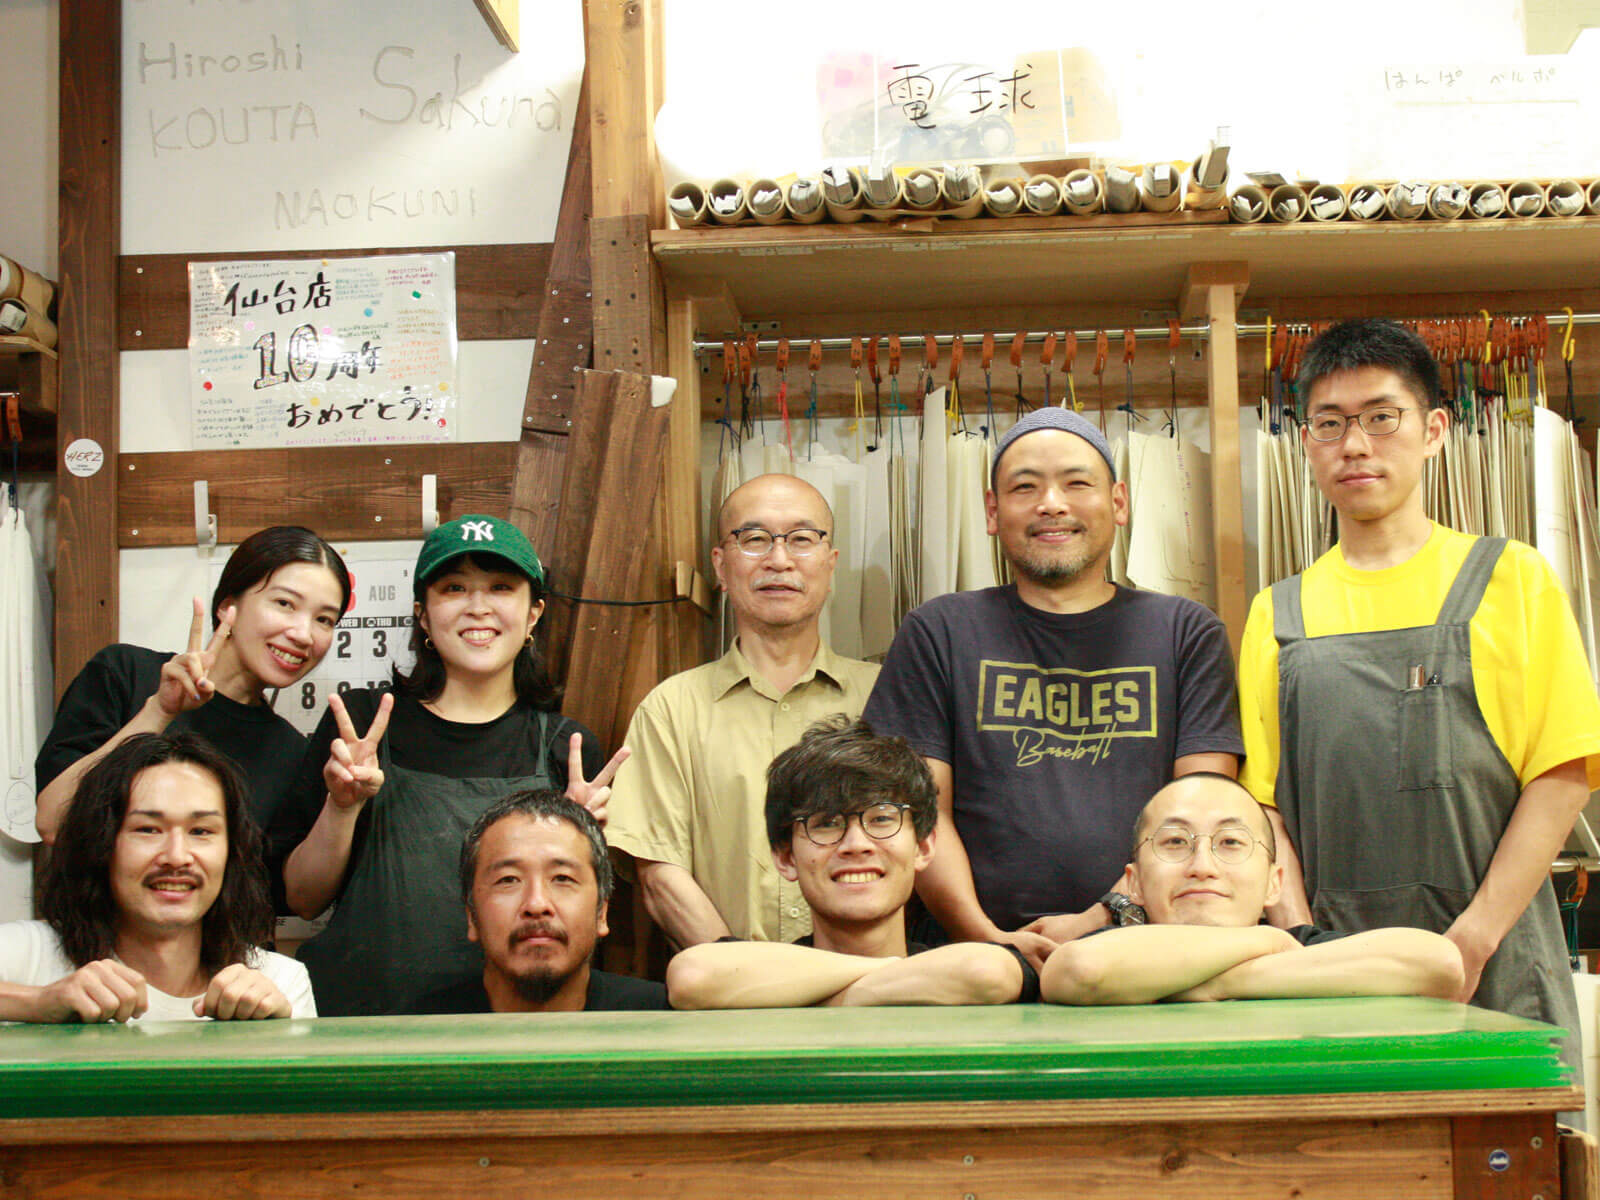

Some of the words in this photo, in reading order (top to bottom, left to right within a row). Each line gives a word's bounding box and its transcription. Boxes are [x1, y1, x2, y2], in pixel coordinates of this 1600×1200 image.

[138, 34, 303, 84] Hiroshi
[359, 45, 561, 132] Sakura
[887, 63, 1036, 129] 電球
[149, 101, 319, 158] KOUTA
[274, 185, 477, 230] NAOKUNI
[223, 271, 332, 317] 仙台店
[369, 585, 397, 602] AUG
[337, 630, 352, 659] 2
[372, 630, 387, 658] 3
[301, 681, 316, 710] 8
[994, 674, 1140, 727] EAGLES
[1013, 722, 1118, 767] Baseball
